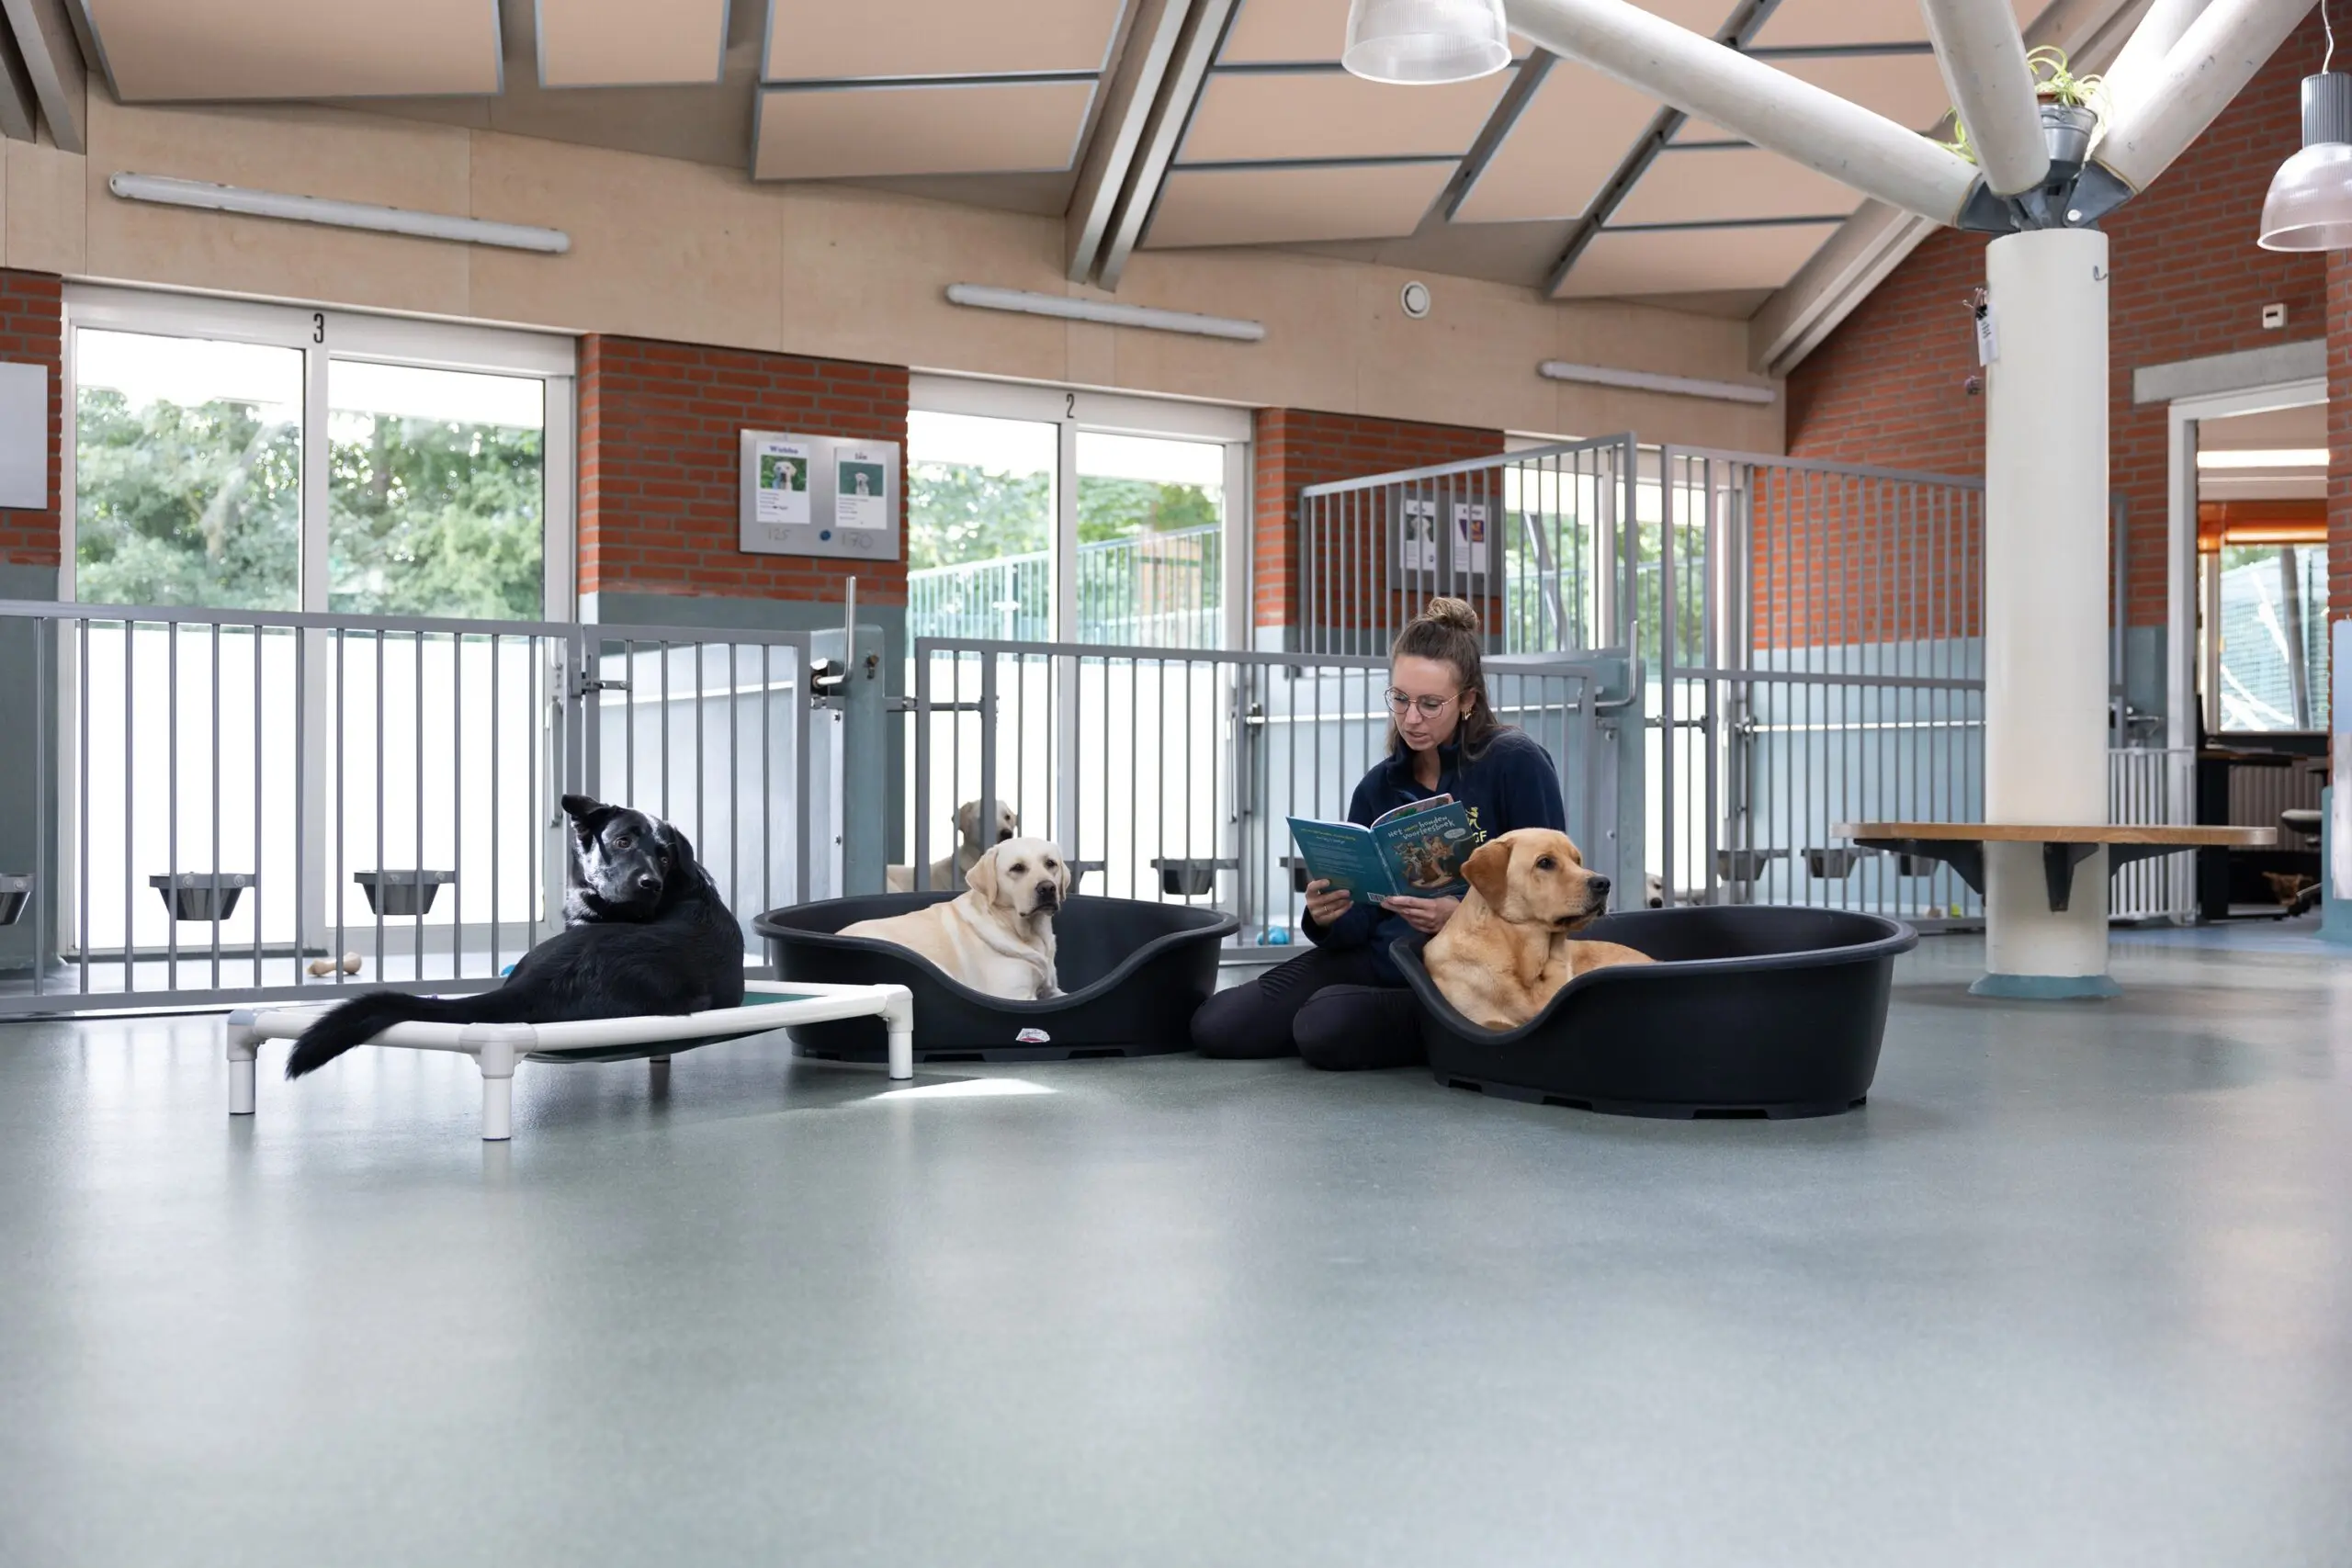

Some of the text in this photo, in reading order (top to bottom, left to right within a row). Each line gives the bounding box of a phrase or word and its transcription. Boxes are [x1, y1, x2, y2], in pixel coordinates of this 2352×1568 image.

[313, 312, 324, 344] 3
[1066, 392, 1075, 419] 2
[842, 531, 874, 550] 170
[1387, 828, 1404, 838] Het
